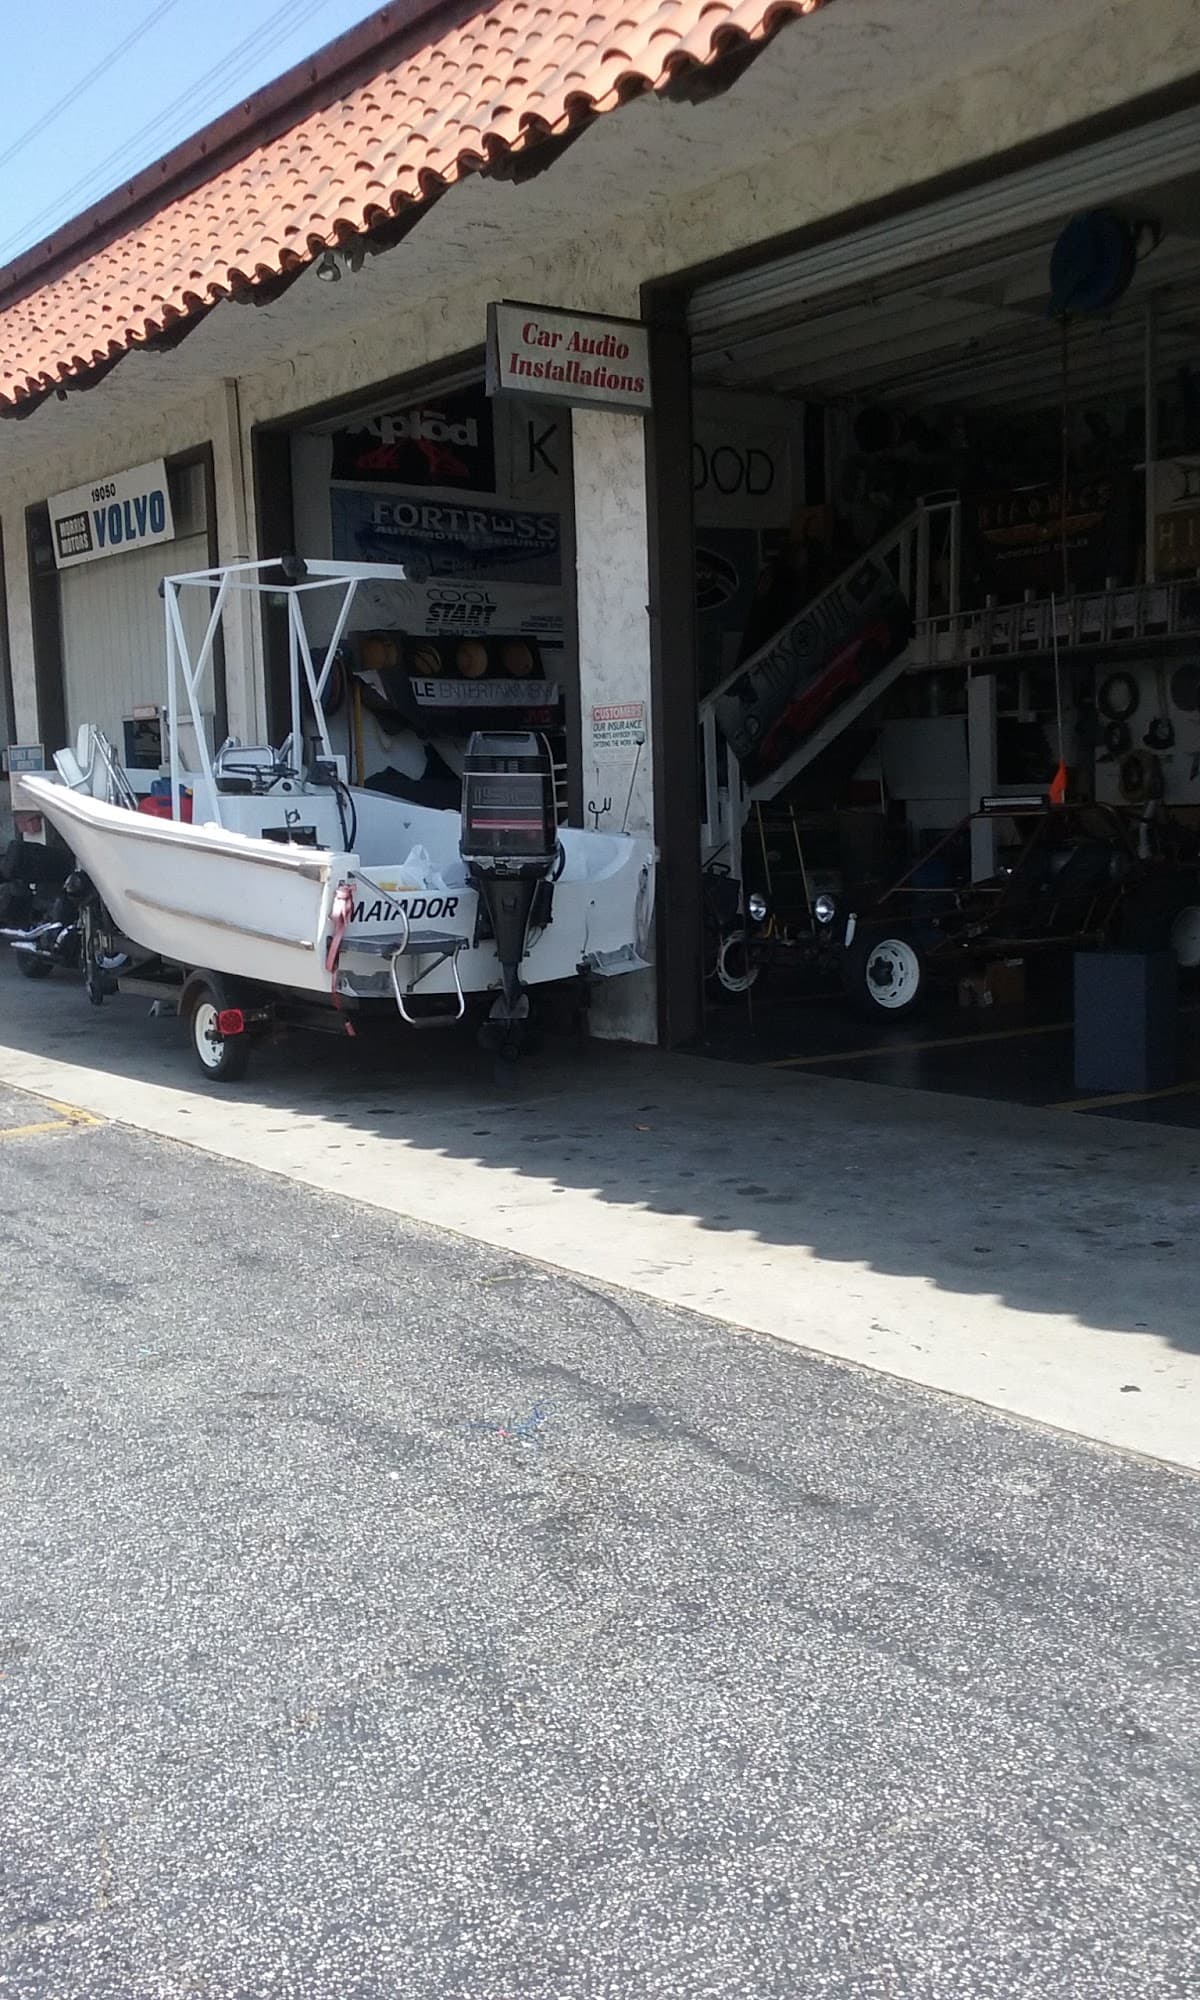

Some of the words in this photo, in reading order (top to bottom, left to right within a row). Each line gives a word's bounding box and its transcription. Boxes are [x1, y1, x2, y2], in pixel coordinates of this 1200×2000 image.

[522, 322, 562, 348] Car
[566, 330, 629, 360] Audio
[508, 353, 644, 392] Installations
[91, 483, 117, 502] 19050
[93, 490, 166, 548] VOLVO
[371, 502, 557, 540] FORTRESS
[61, 532, 89, 554] MOTORS
[426, 588, 497, 604] COOL
[425, 602, 497, 625] START
[607, 720, 642, 731] INSURANCE
[350, 897, 459, 922] MATADOR
